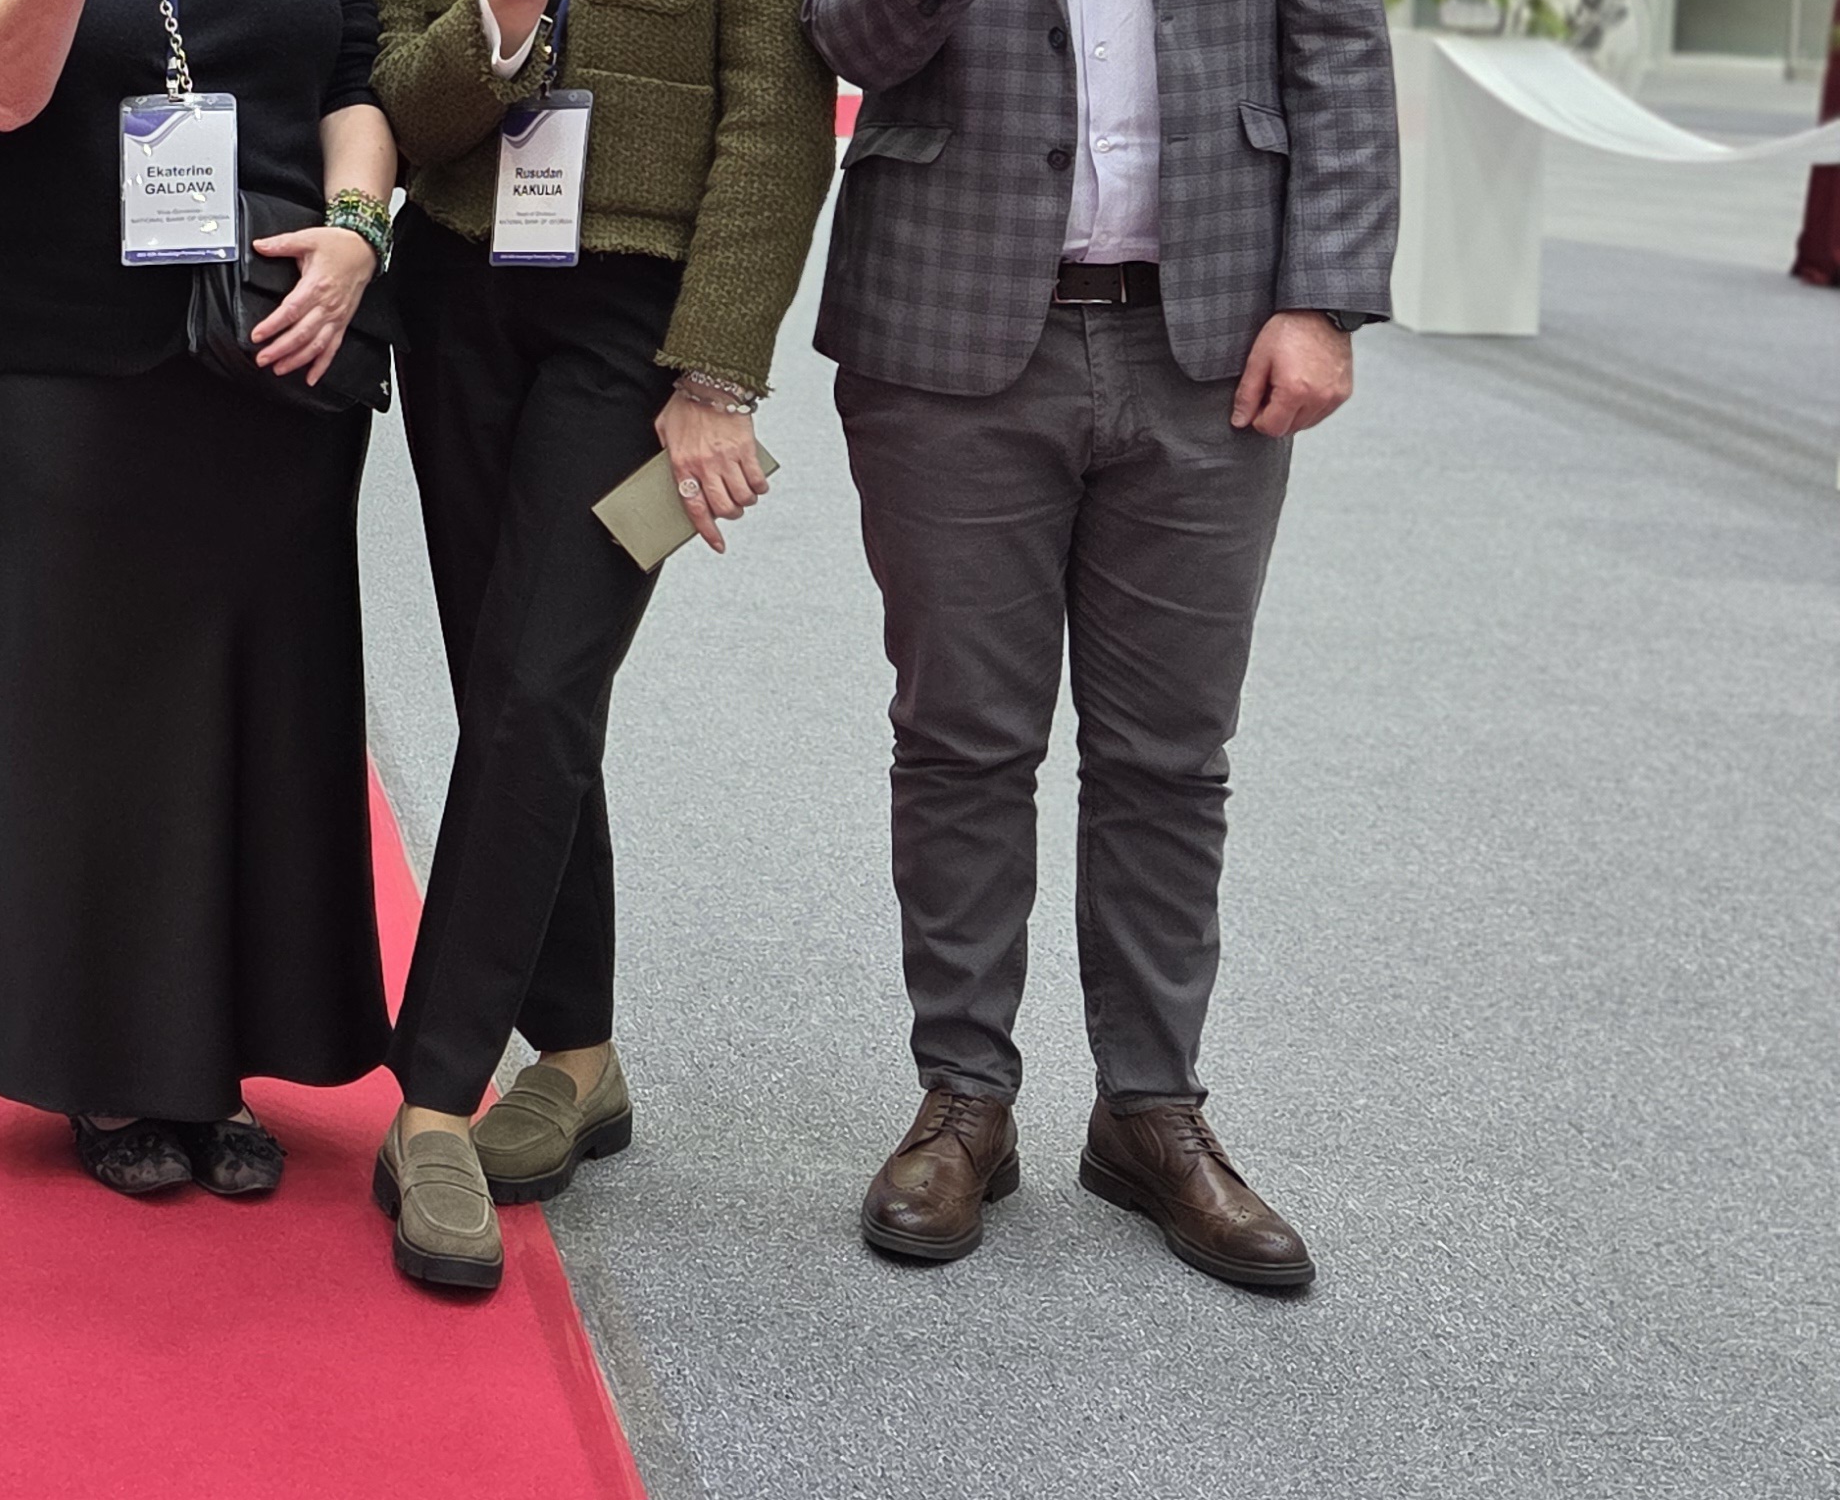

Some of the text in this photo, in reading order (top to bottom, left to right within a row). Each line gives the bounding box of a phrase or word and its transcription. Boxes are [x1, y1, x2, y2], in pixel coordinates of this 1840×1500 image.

[146, 165, 213, 178] Ekaterine
[515, 167, 563, 179] Rusudan
[144, 181, 216, 195] GALDAVA
[512, 184, 563, 196] KAKULIA
